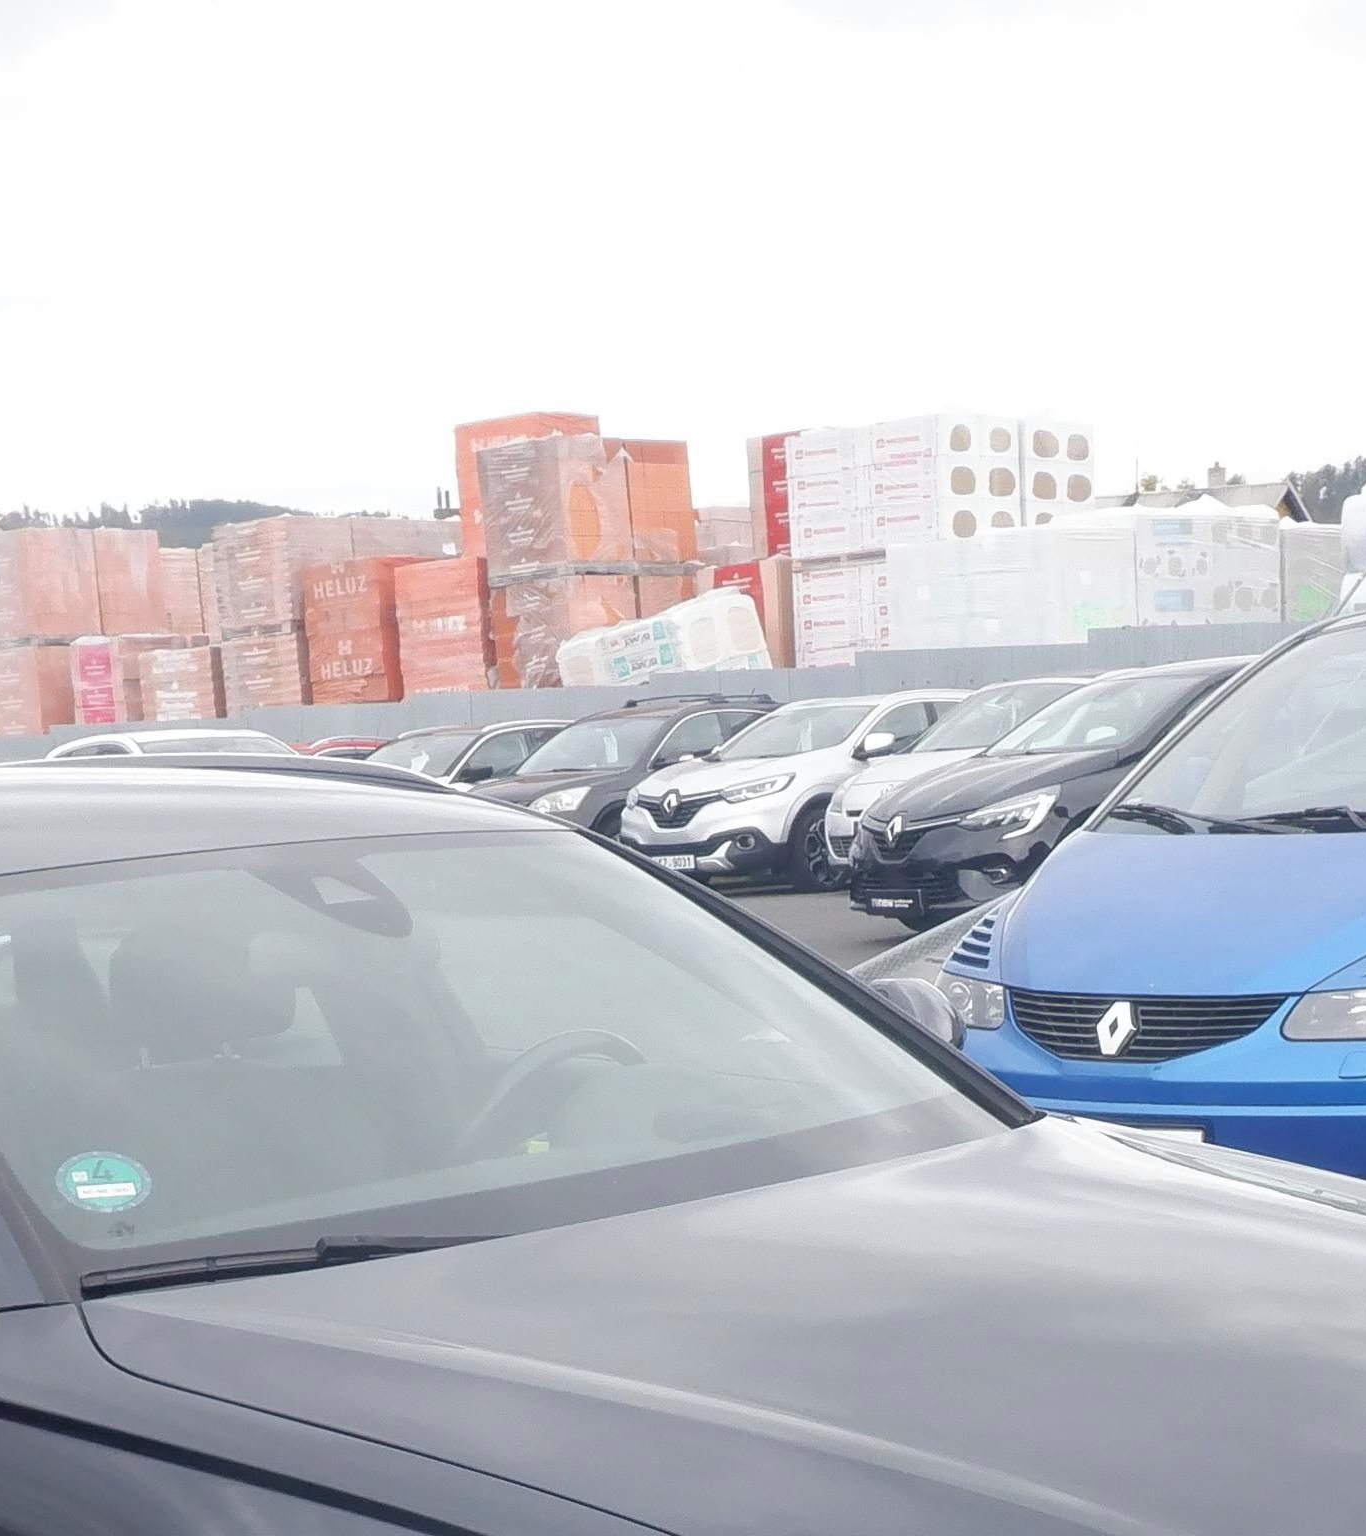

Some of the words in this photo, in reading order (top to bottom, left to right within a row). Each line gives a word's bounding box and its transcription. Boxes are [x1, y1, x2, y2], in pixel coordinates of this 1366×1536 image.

[313, 575, 368, 599] HELUZ
[320, 658, 373, 680] HELUZ
[91, 1159, 114, 1181] 4
